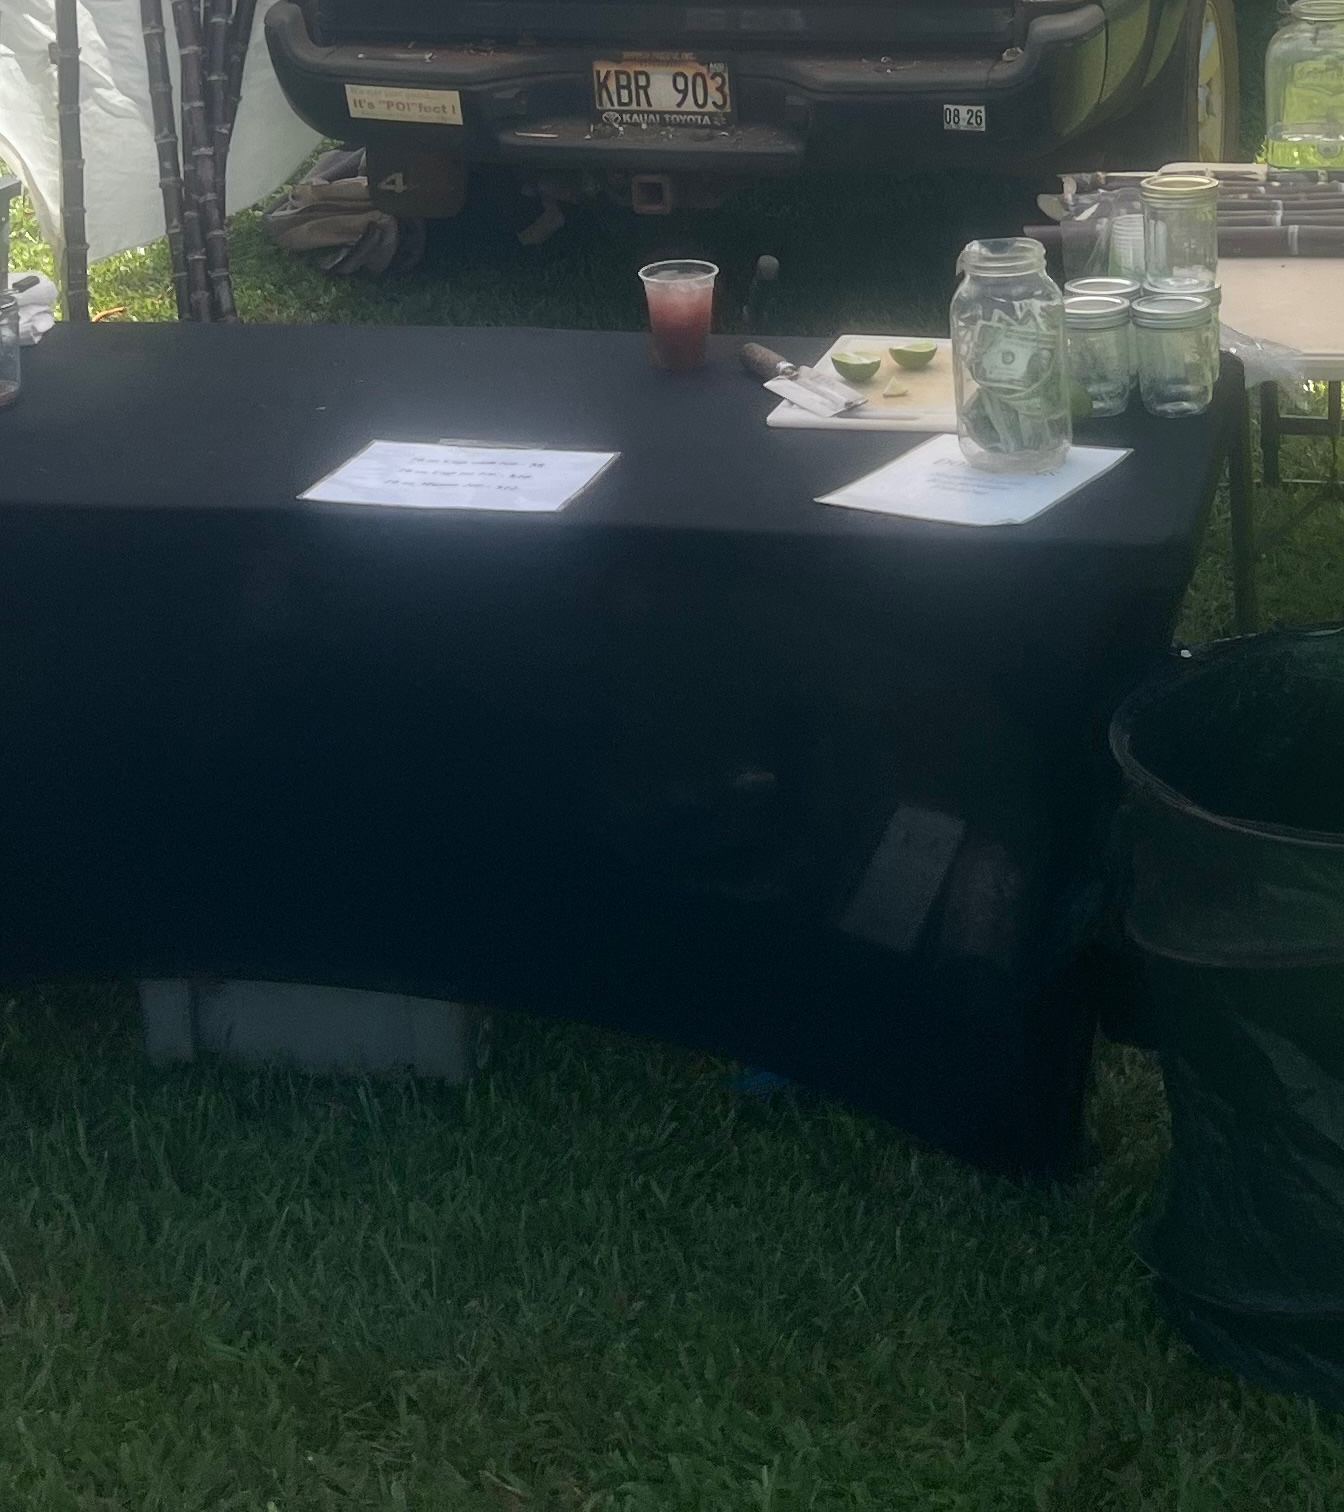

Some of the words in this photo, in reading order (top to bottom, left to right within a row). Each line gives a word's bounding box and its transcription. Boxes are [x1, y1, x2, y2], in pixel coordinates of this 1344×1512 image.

[595, 69, 653, 108] KBR
[672, 71, 729, 110] 903
[663, 114, 712, 125] TOYOTA
[944, 107, 961, 125] 08
[966, 108, 983, 126] 26
